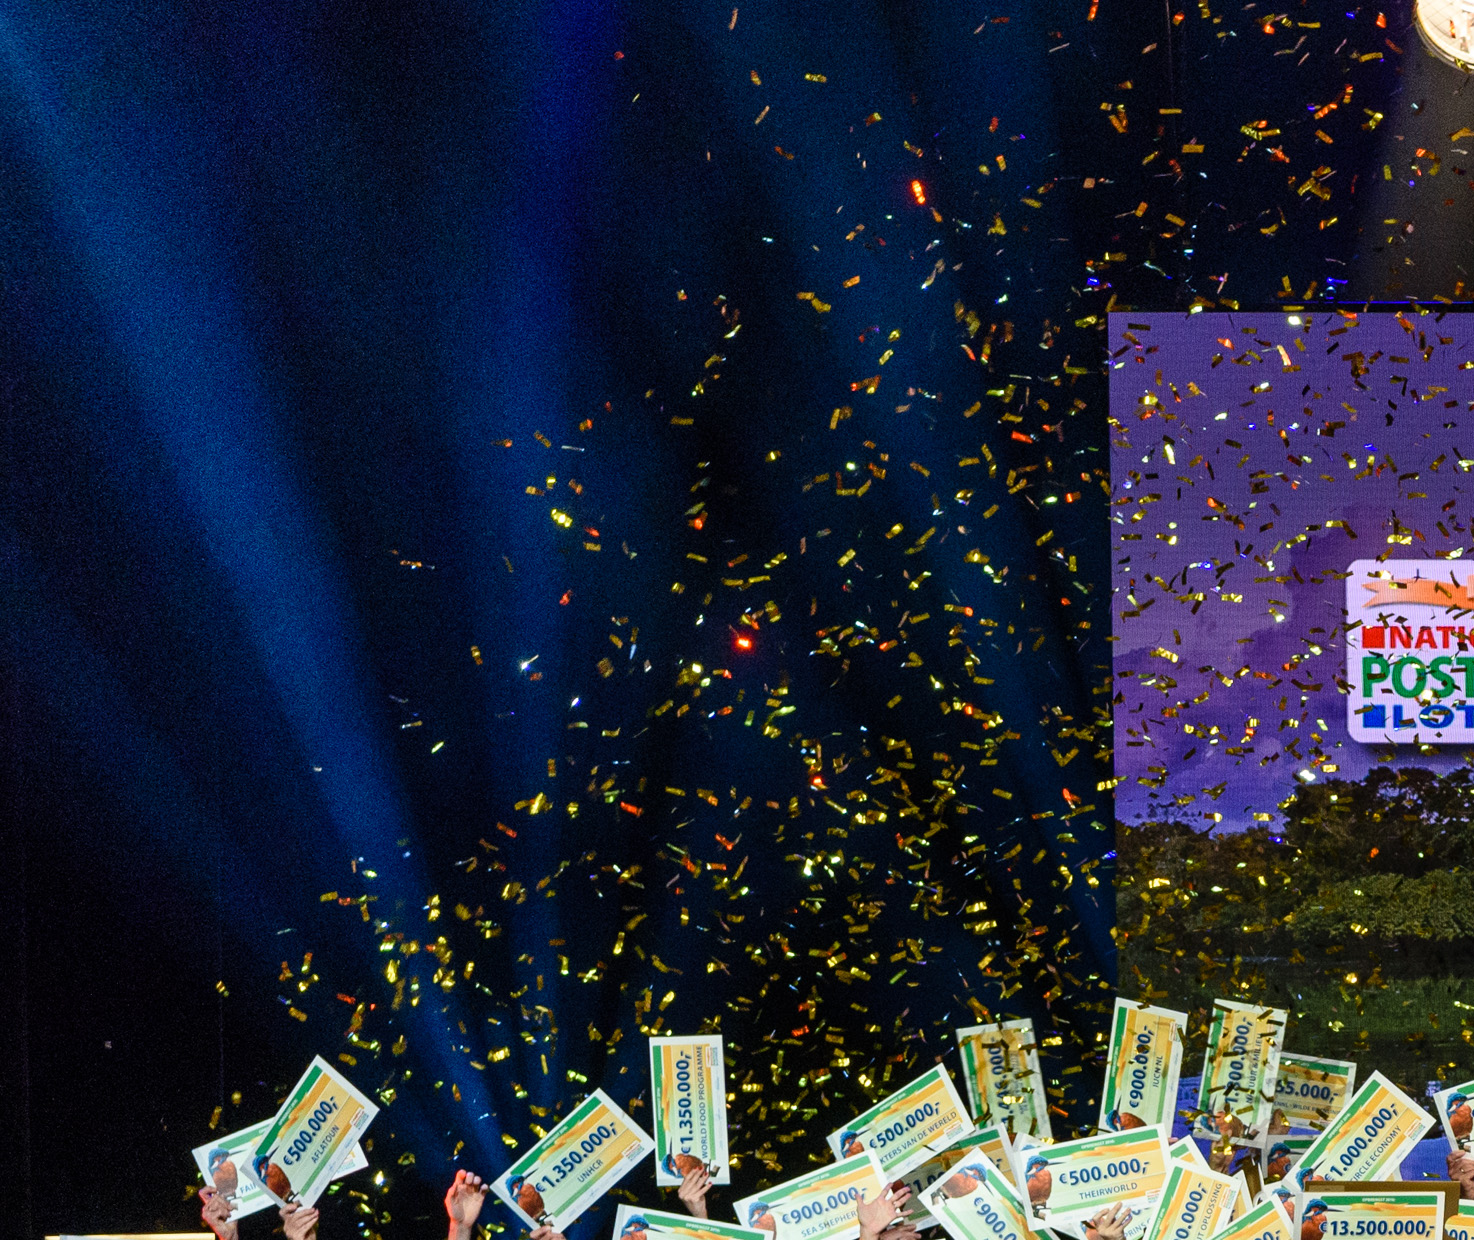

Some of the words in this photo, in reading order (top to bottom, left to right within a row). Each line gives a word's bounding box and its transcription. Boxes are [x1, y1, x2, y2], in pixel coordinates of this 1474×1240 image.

[676, 1050, 694, 1154] €1.350.000,-
[282, 1095, 341, 1168] €500.000,-
[869, 1101, 941, 1150] €500.000,-
[1324, 1103, 1400, 1182] €1.000.000,-
[535, 1120, 620, 1194] €1.350.000,-
[577, 1158, 604, 1184] UNHCR
[1059, 1160, 1150, 1187] €500.000,-
[781, 1184, 868, 1226] €900.000,-
[1079, 1183, 1138, 1200] THEIRWORLD
[1319, 1220, 1436, 1238] €13.500.000,-
